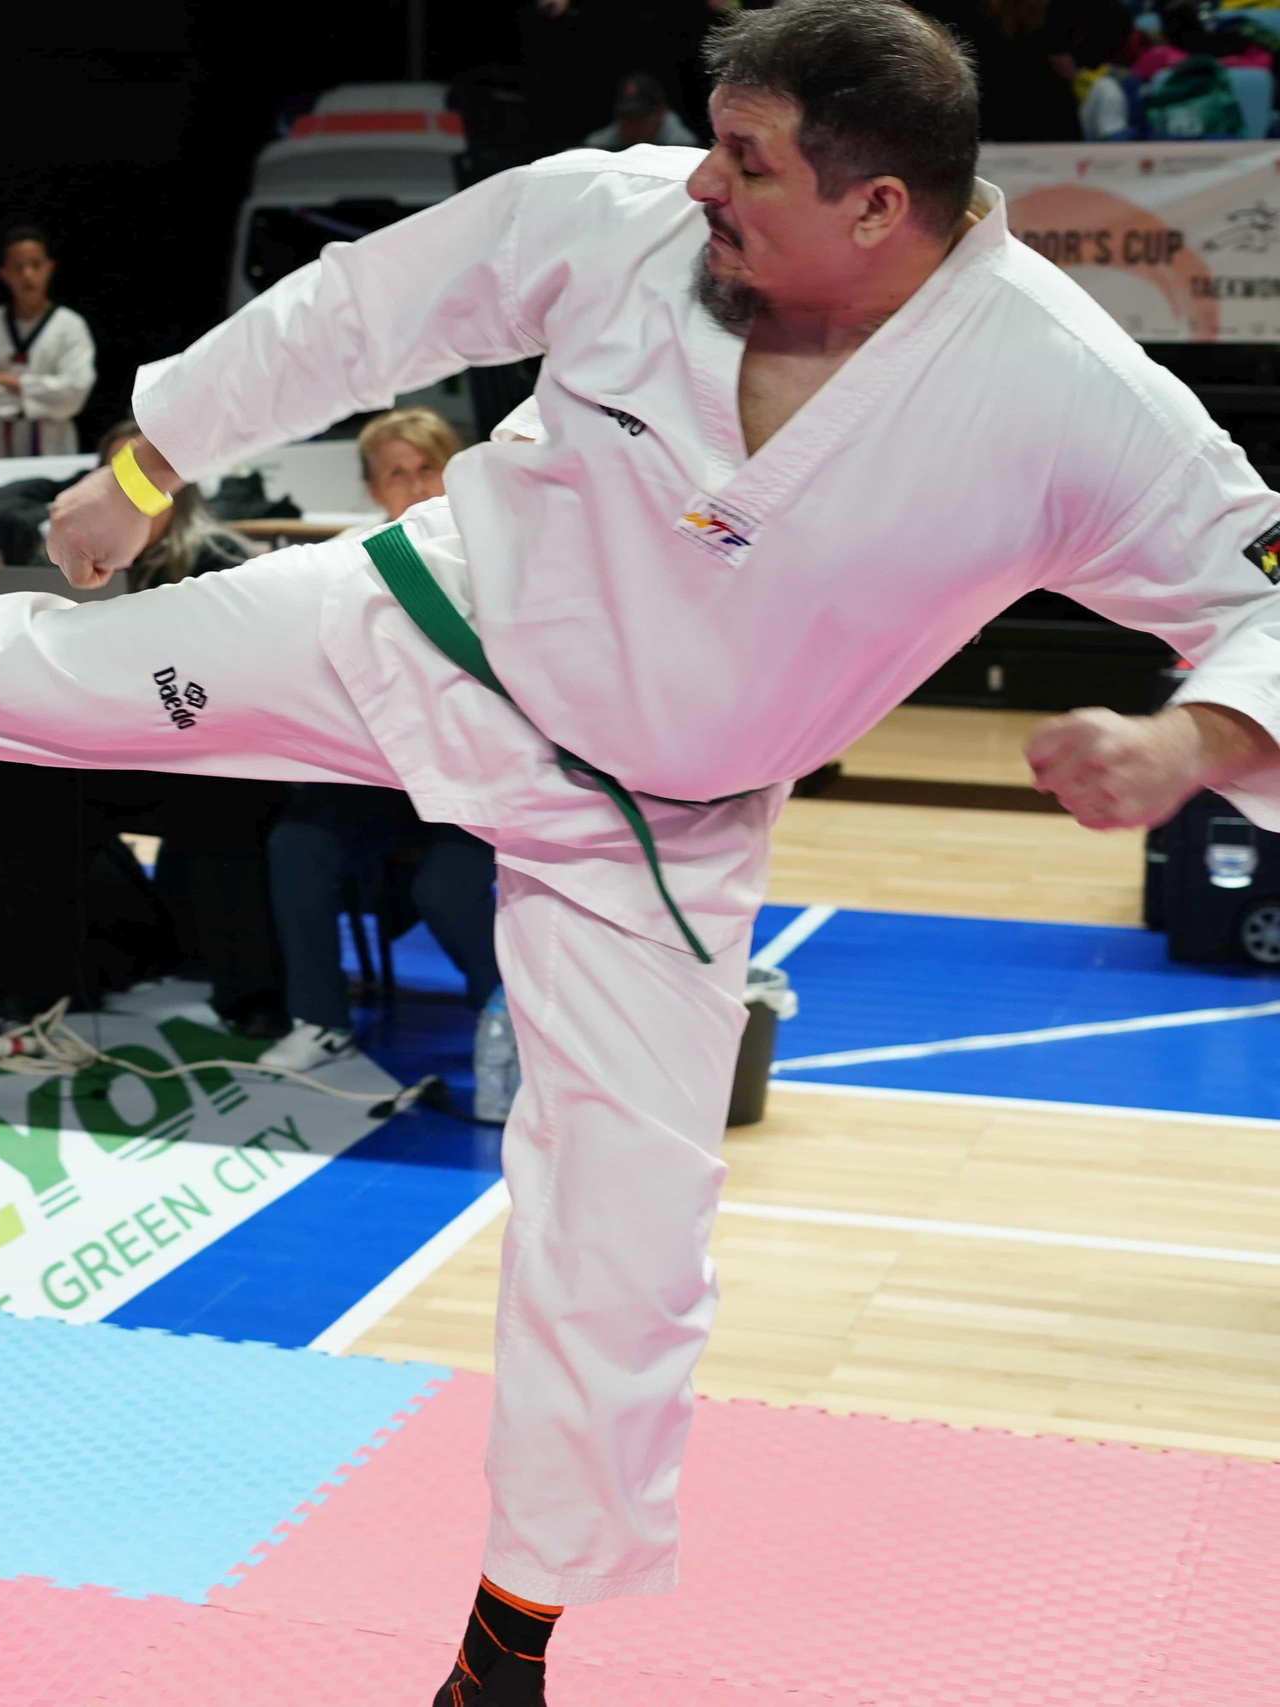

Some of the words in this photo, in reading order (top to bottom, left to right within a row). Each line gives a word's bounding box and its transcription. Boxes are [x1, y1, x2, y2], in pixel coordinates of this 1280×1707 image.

[1123, 229, 1184, 267] CUP
[152, 666, 197, 730] Daedo
[40, 1183, 213, 1311] GREEN
[212, 1114, 312, 1194] CITY
